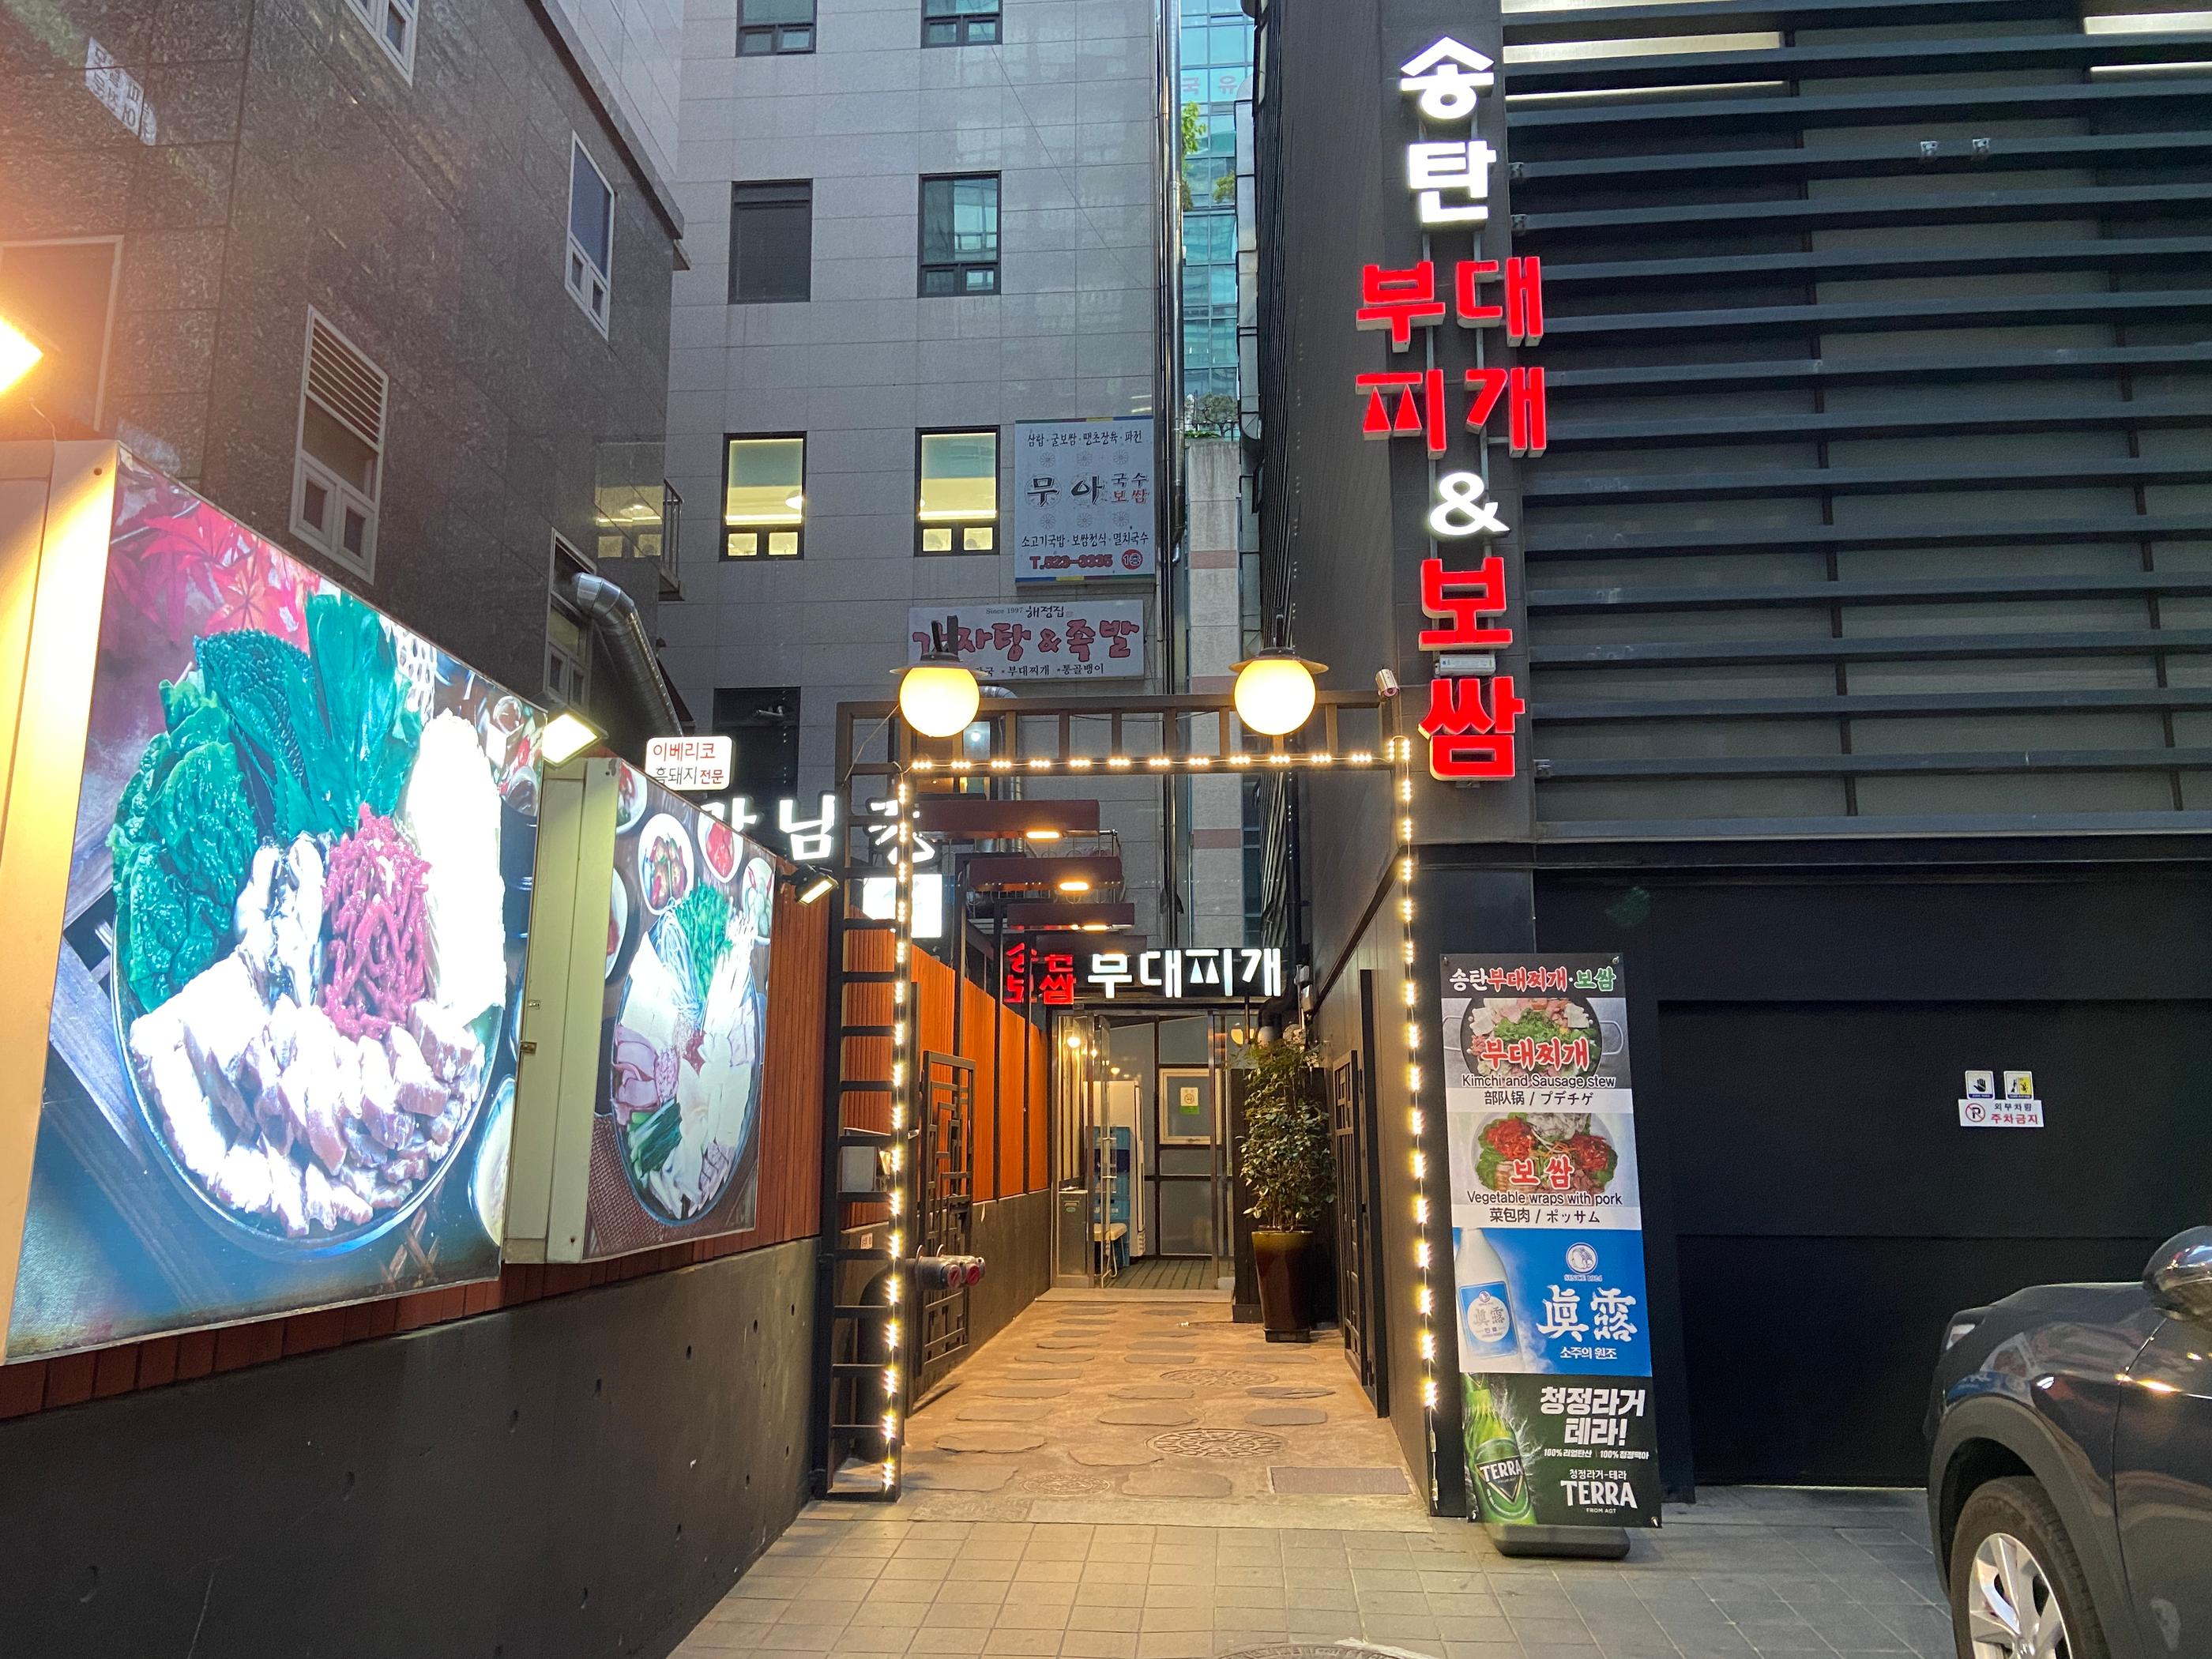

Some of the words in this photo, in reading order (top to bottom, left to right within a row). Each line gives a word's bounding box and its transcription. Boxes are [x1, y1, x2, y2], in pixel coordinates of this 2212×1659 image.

[1400, 36, 1496, 223] 송탄
[1356, 256, 1544, 351] 부대
[1356, 367, 1546, 460] 찌개
[1112, 472, 1148, 487] 국수
[1112, 489, 1149, 504] 보쌈
[1429, 472, 1510, 536] &
[1021, 534, 1066, 548] 소고기국밥
[1072, 532, 1107, 547] 보쌈정식
[1113, 530, 1149, 546] 멸치국수
[1008, 664, 1050, 677] 부대찌개
[1418, 557, 1525, 781] 보쌈
[653, 742, 716, 762] 이베리코
[700, 769, 724, 784] 전문
[1087, 948, 1281, 999] 부대찌개
[1480, 1036, 1590, 1071] 부대찌개
[1462, 1074, 1502, 1087] Kimchi
[1506, 1074, 1529, 1087] and
[1532, 1075, 1584, 1088] Sausage
[1587, 1075, 1616, 1088] stew
[1484, 1090, 1525, 1105] 部队锅
[1540, 1090, 1594, 1105] プデチゲ
[1991, 1113, 2038, 1125] 주차금지
[1508, 1156, 1575, 1190] 보쌈
[1467, 1191, 1525, 1205] Vegetable
[1529, 1194, 1564, 1206] wraps
[1567, 1193, 1591, 1205] with
[1595, 1193, 1623, 1206] pork
[1490, 1207, 1529, 1223] 菜包肉
[1546, 1209, 1601, 1223] ポッサム
[1559, 1346, 1593, 1360] 소주의
[1594, 1347, 1618, 1360] 원조
[1540, 1386, 1646, 1417] 청정라거
[1563, 1417, 1628, 1446] 테라!
[1600, 1450, 1619, 1459] 100%
[1480, 1459, 1524, 1482] TERRA
[1560, 1480, 1638, 1509] TERRA
